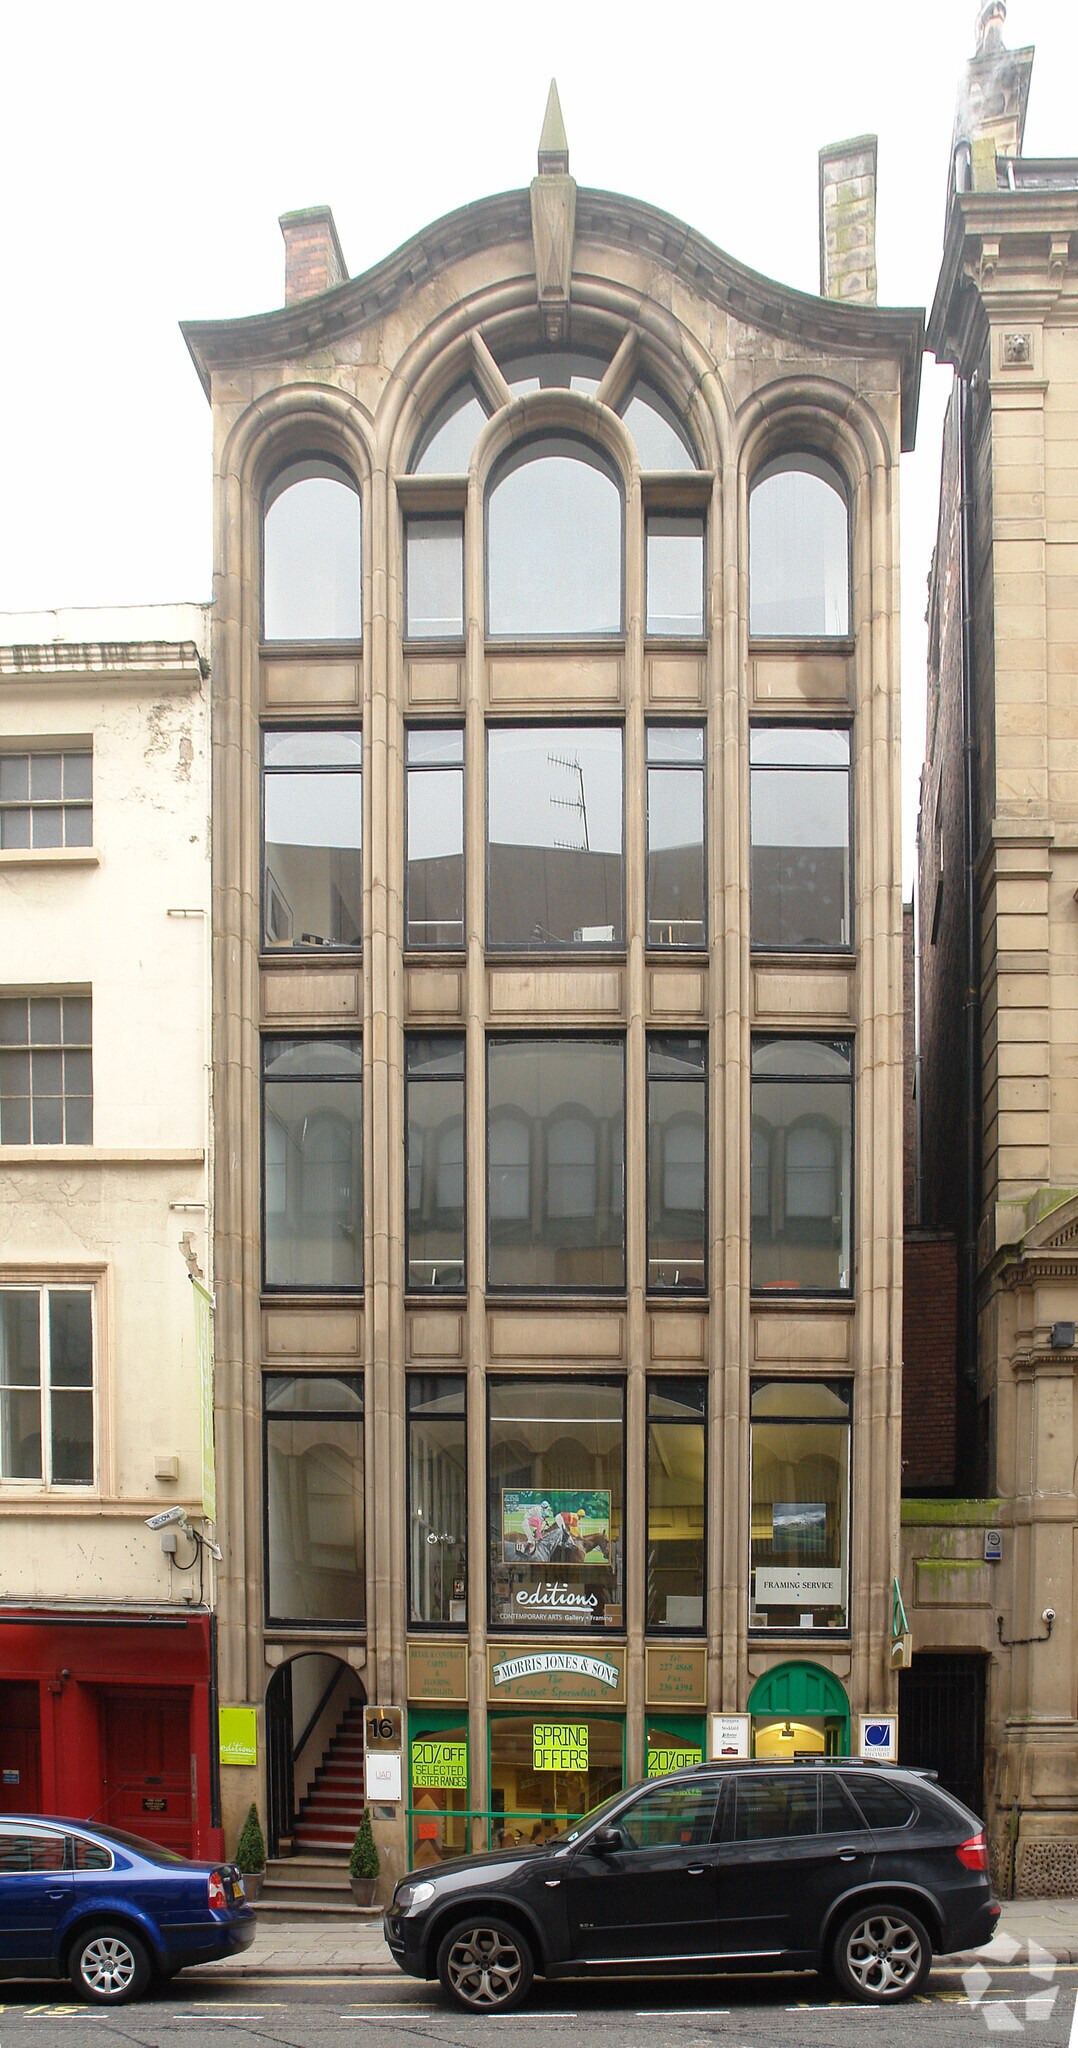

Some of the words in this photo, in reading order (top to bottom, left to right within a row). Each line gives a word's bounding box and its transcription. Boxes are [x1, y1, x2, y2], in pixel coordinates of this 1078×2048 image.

[763, 1581, 800, 1589] FRAMING
[802, 1581, 834, 1589] SERVICE
[516, 1582, 598, 1606] editions
[499, 1613, 547, 1621] CONTEMPORARY
[548, 1613, 562, 1621] ARTS
[564, 1614, 584, 1622] Gallery
[501, 1657, 542, 1678] MORRIS
[544, 1655, 578, 1671] JONES
[580, 1659, 589, 1672] &
[591, 1662, 613, 1681] SON
[547, 1673, 563, 1684] The
[516, 1685, 547, 1698] Carpet
[551, 1685, 597, 1698] Specialists
[369, 1718, 393, 1738] 16
[534, 1726, 588, 1746] SPRING
[220, 1742, 255, 1752] editions
[413, 1744, 441, 1764] 20%
[443, 1748, 466, 1761] OFF
[534, 1750, 588, 1769] OFFERS
[648, 1751, 675, 1770] 20%
[676, 1754, 701, 1767] OFF
[416, 1765, 464, 1775] SELECTED
[412, 1776, 439, 1786] ULSTER
[440, 1776, 467, 1787] RANGES
